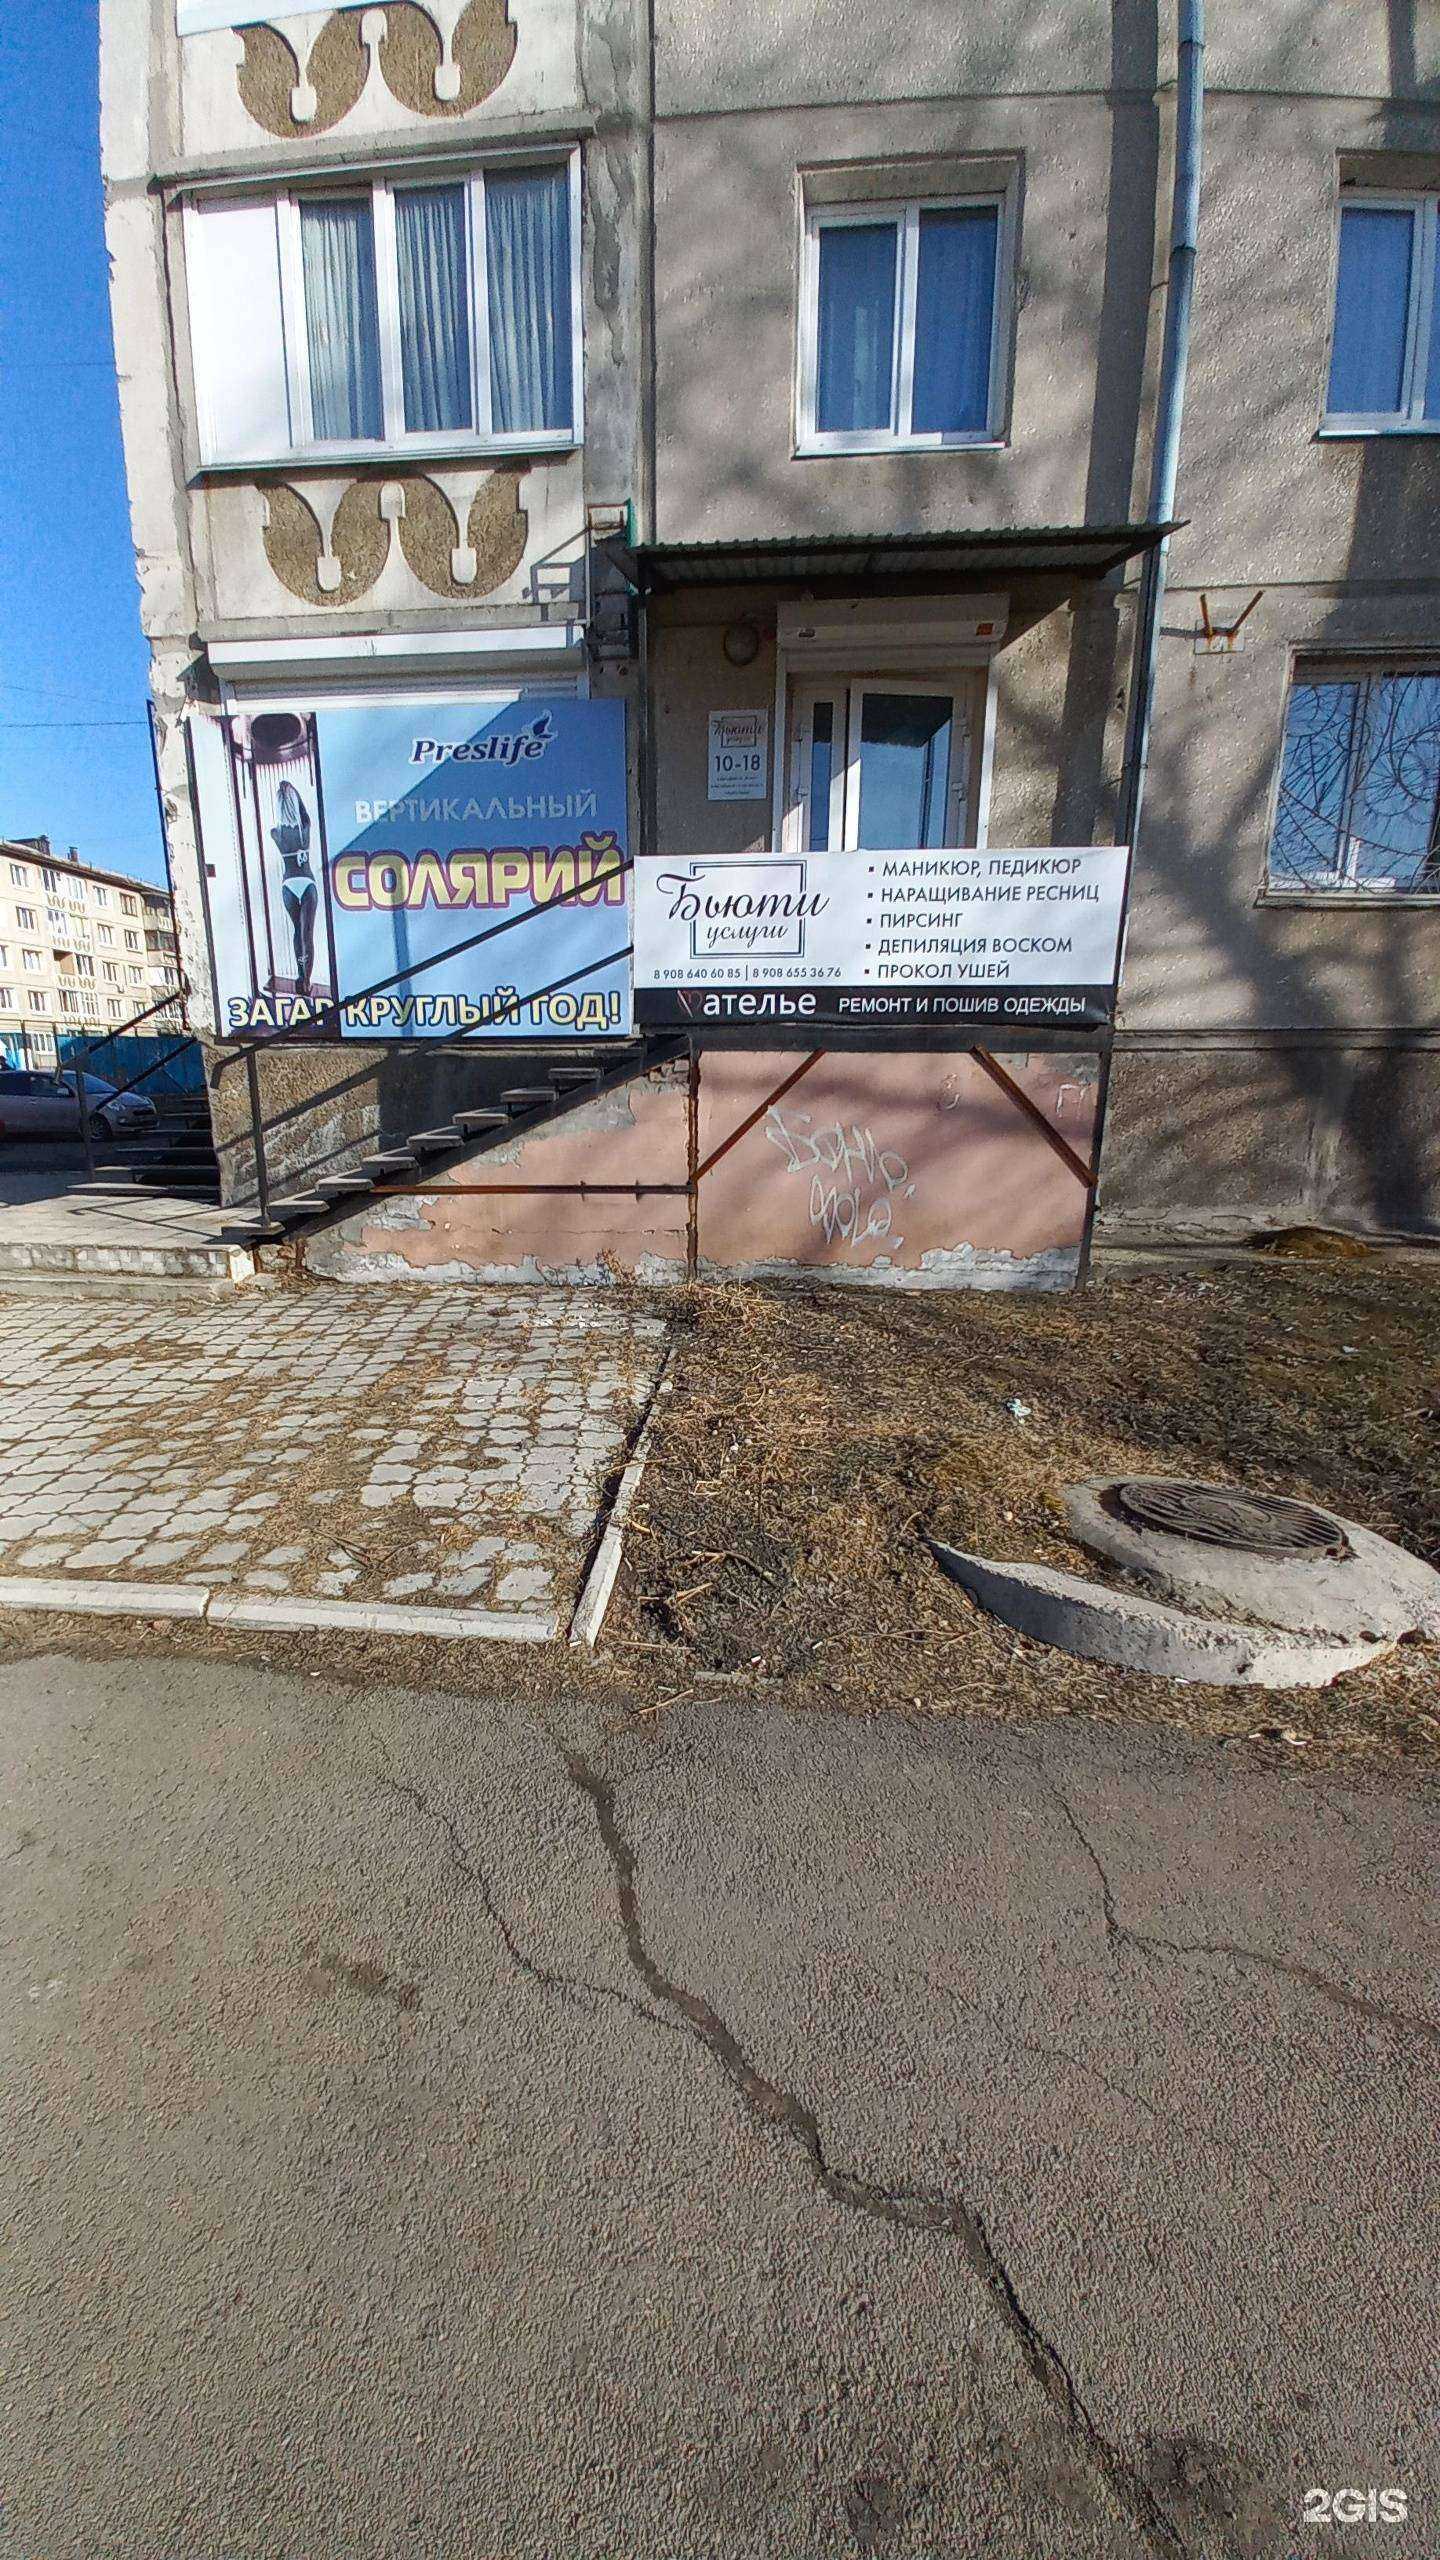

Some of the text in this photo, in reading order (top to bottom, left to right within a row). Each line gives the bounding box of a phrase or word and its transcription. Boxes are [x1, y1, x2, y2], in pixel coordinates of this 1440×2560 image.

[411, 733, 547, 765] Preslife
[715, 754, 760, 772] 10-18
[354, 790, 597, 824] ВЕРТИКАЛЬНЫЙ
[333, 831, 626, 911] СОЛЯРИЙ
[882, 858, 1081, 878] МАНИКЮР, ПЕДИКЮР
[656, 873, 830, 921] Бьюти
[881, 885, 1099, 904] НАРАЩИВАНИЕ РЕСНИЦ
[880, 912, 963, 929] ПИРСИНГ
[706, 924, 789, 948] услуги
[878, 937, 1072, 956] ДЕПИЛЯЦИЯ ВОСКОМ
[653, 968, 741, 979] 8 908 640 60 85
[752, 967, 842, 978] 8 908 655 36 76
[877, 960, 1010, 979] ПРОКОЛ УШЕЙ
[345, 986, 520, 1028] КРУГЛЫЙ
[530, 991, 622, 1031] ГОД!
[703, 992, 817, 1016] ателье
[838, 997, 1086, 1016] РЕМОНТ И ПОШИВ ОДЕЖДЫ
